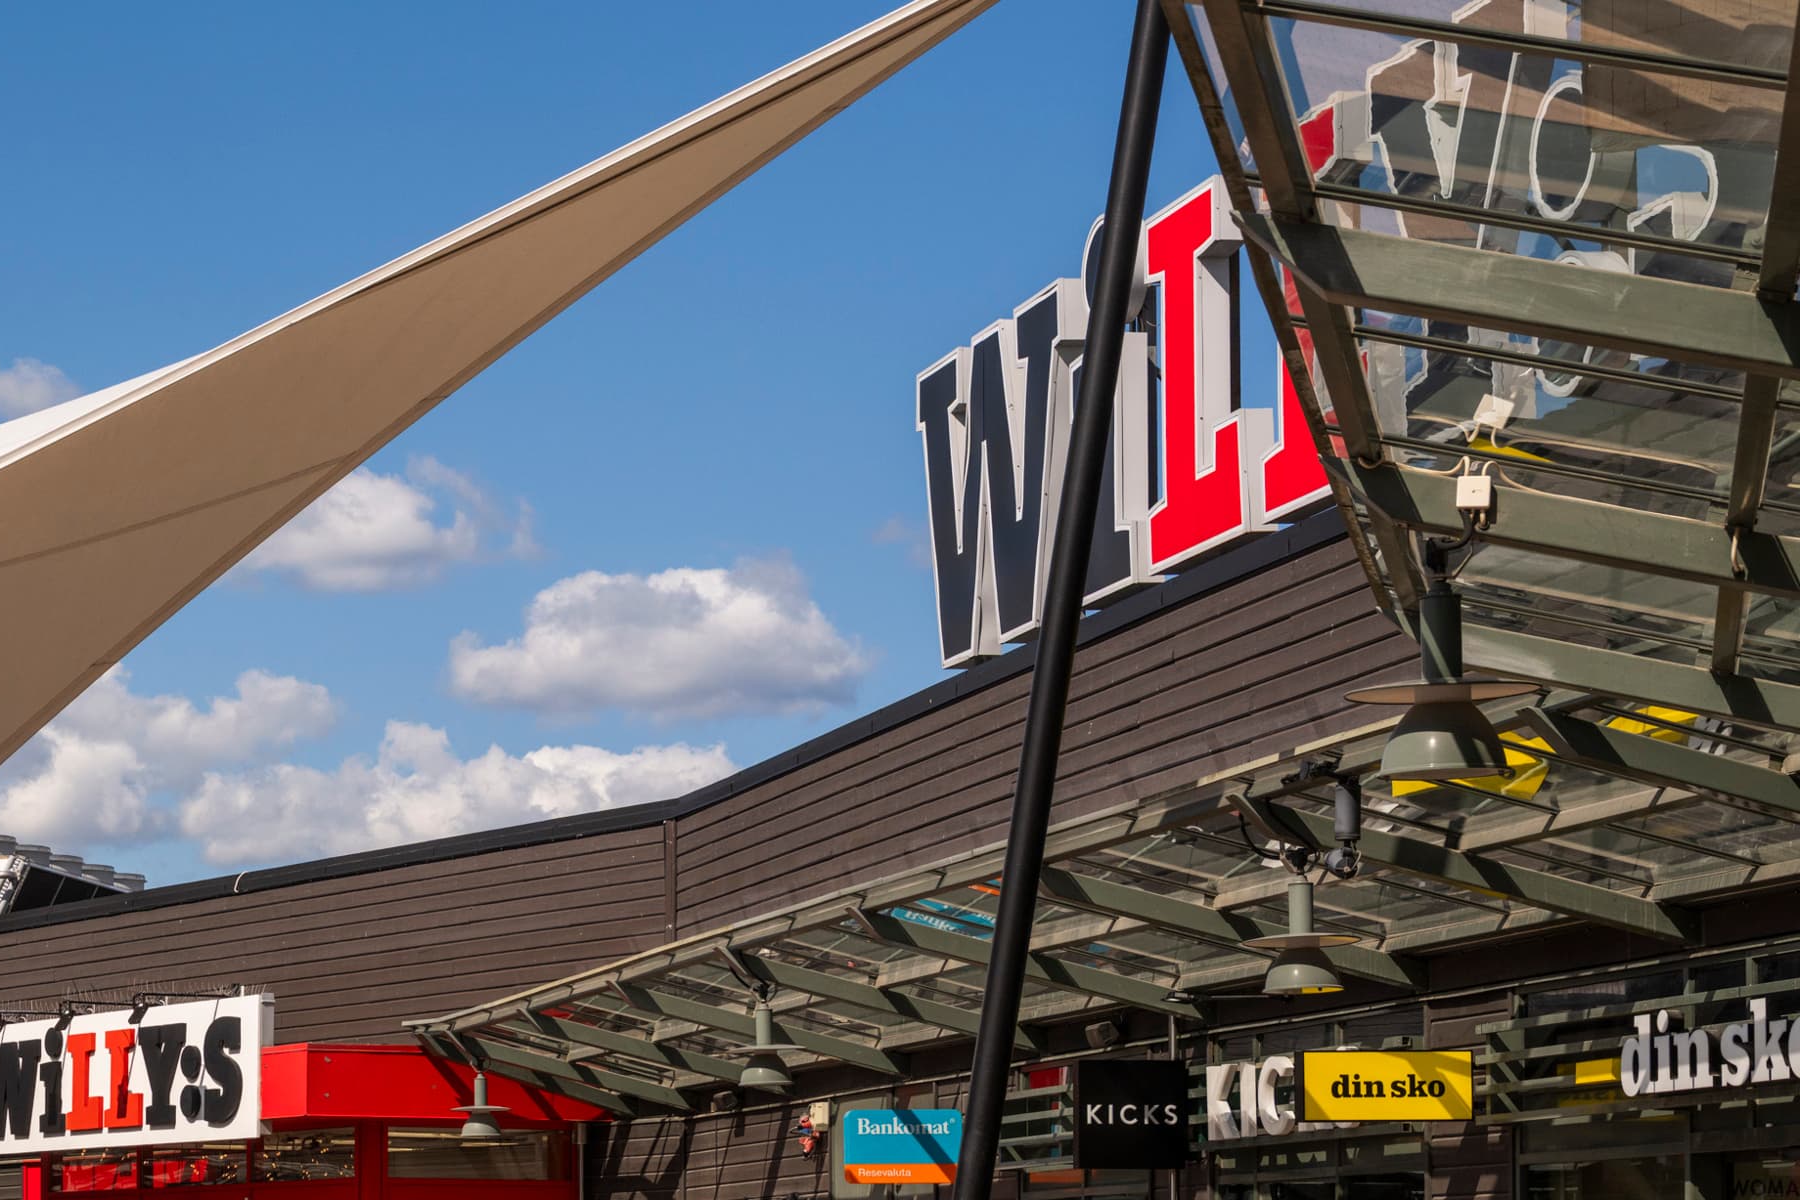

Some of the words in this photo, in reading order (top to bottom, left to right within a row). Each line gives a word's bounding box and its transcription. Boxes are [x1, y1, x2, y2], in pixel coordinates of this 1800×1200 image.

[1621, 1009, 1714, 1098] din
[1331, 1073, 1386, 1099] din
[1390, 1073, 1445, 1098] sko
[1086, 1104, 1178, 1125] KICKS
[857, 1168, 912, 1178] Resevaluta
